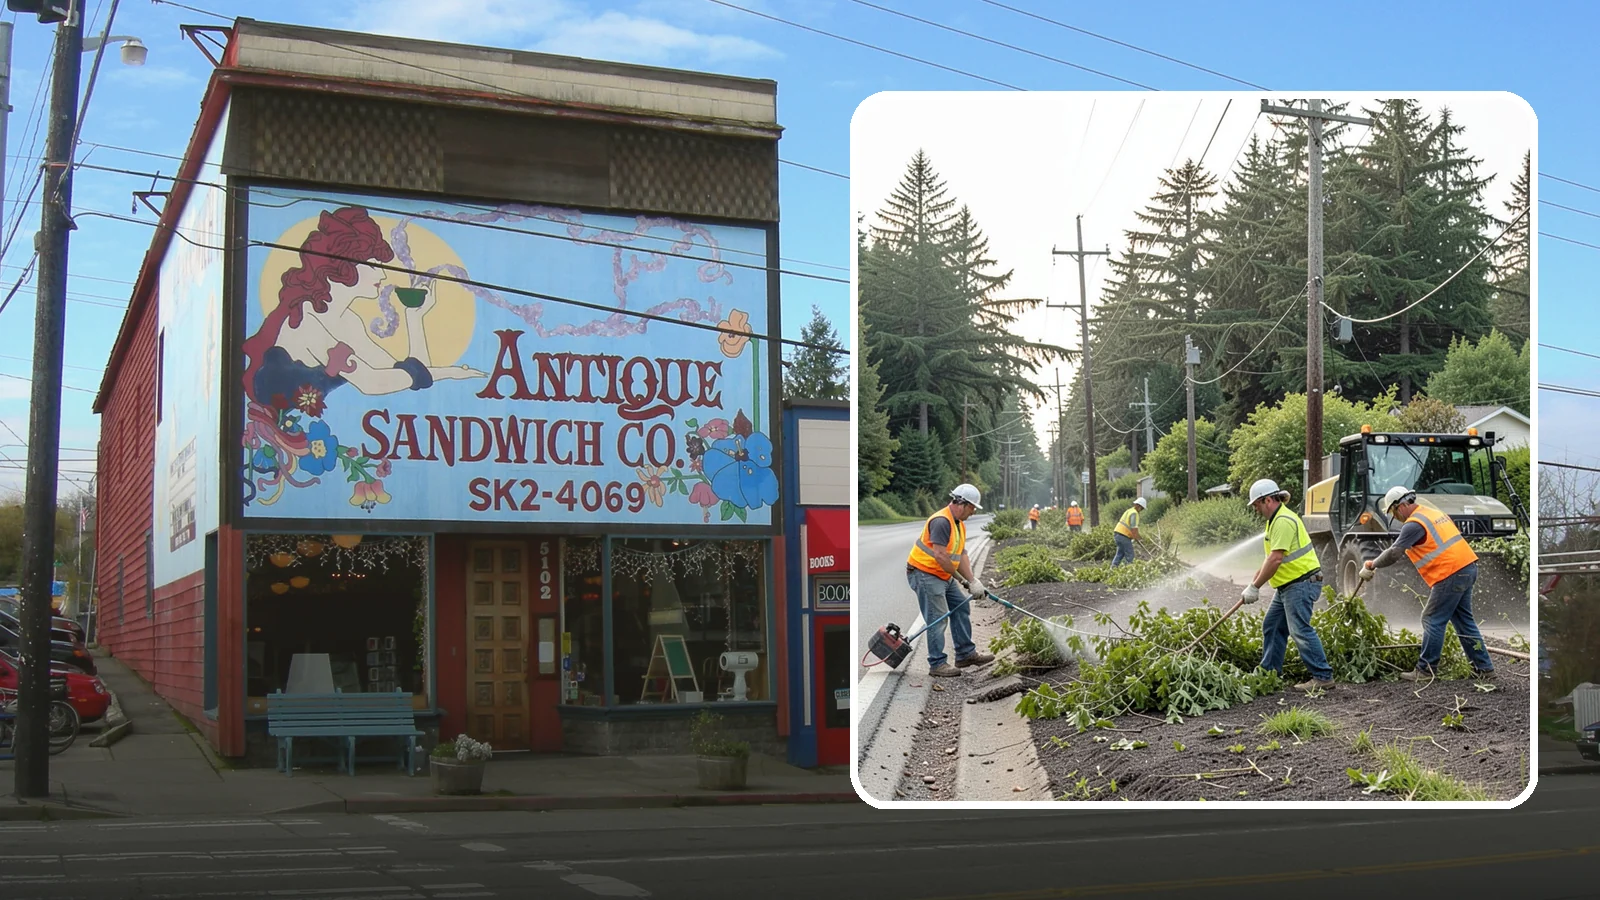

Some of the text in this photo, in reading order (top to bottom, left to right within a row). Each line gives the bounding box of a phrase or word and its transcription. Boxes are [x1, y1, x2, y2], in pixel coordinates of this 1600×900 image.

[476, 328, 724, 421] ANTIQUE
[361, 408, 686, 470] SANDWICH CO.
[468, 477, 647, 514] SK2-4069
[539, 541, 552, 600] 5102
[809, 554, 835, 568] BOOKS
